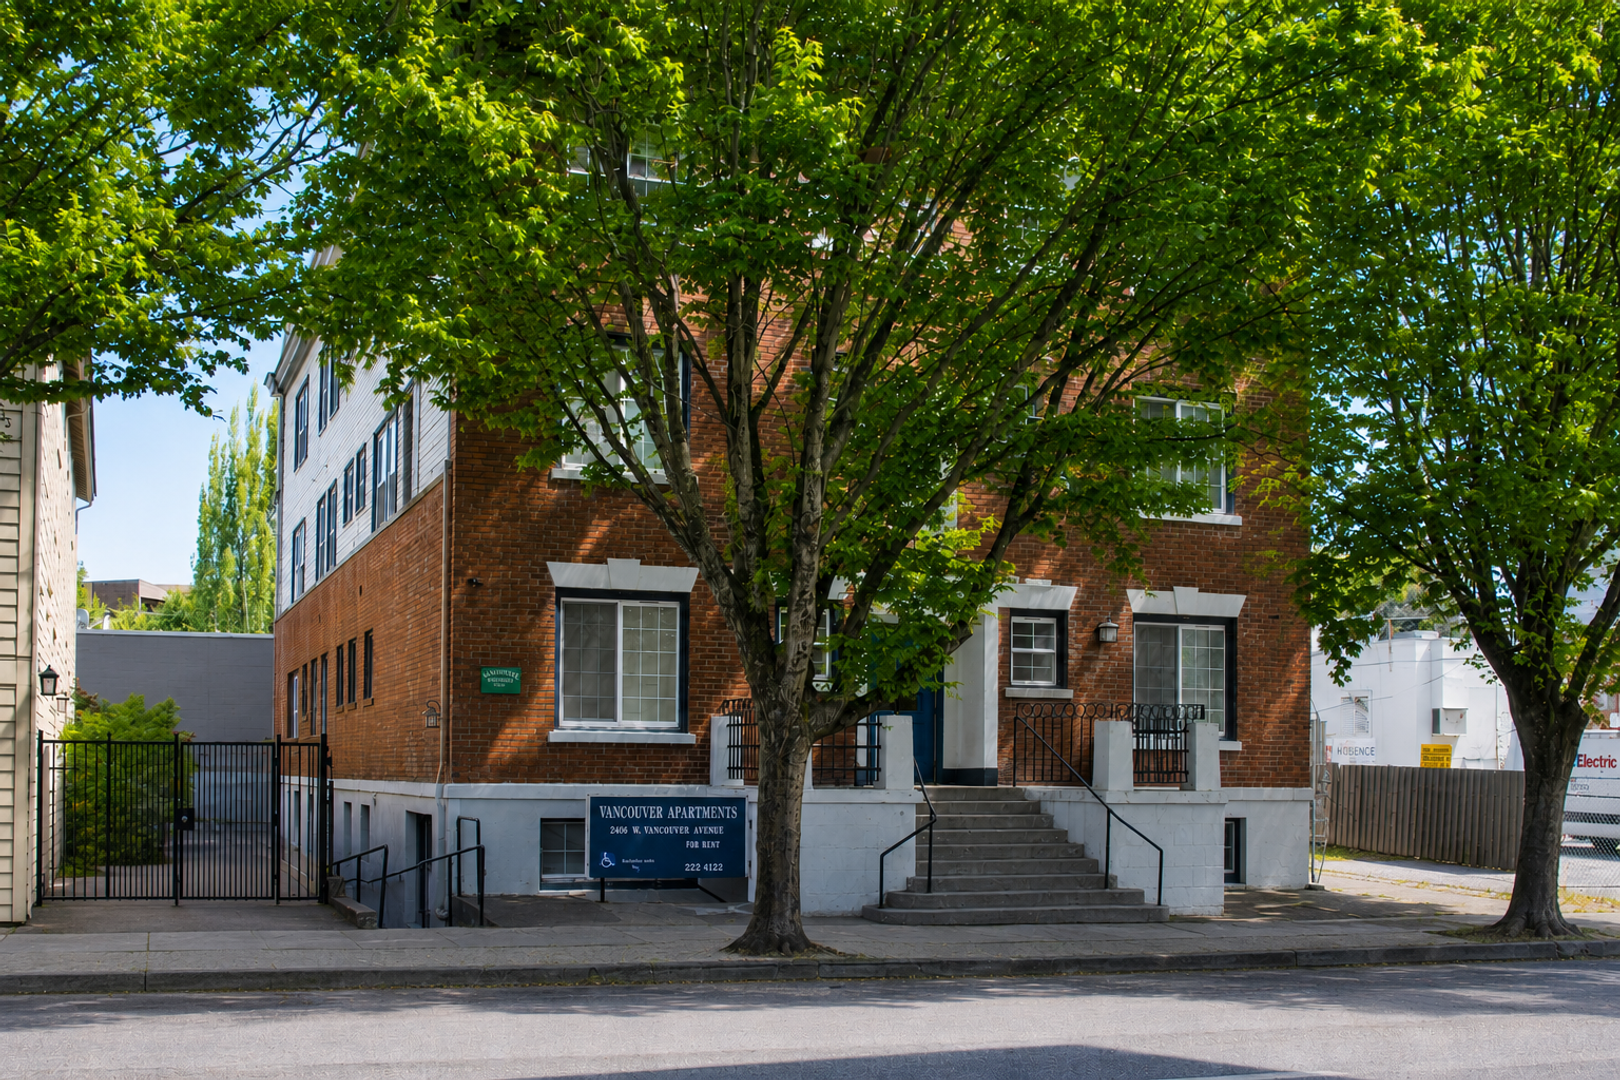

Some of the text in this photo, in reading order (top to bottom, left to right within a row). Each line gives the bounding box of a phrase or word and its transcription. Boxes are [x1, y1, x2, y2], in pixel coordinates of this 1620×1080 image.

[1577, 753, 1618, 768] Electric
[599, 805, 738, 819] VANCOUVER APARTMENTS
[632, 825, 642, 835] W.
[644, 825, 690, 835] VANCOUVER
[693, 825, 724, 835] AVENUE
[686, 840, 721, 849] FOR RENT
[684, 863, 724, 872] 222 4122
